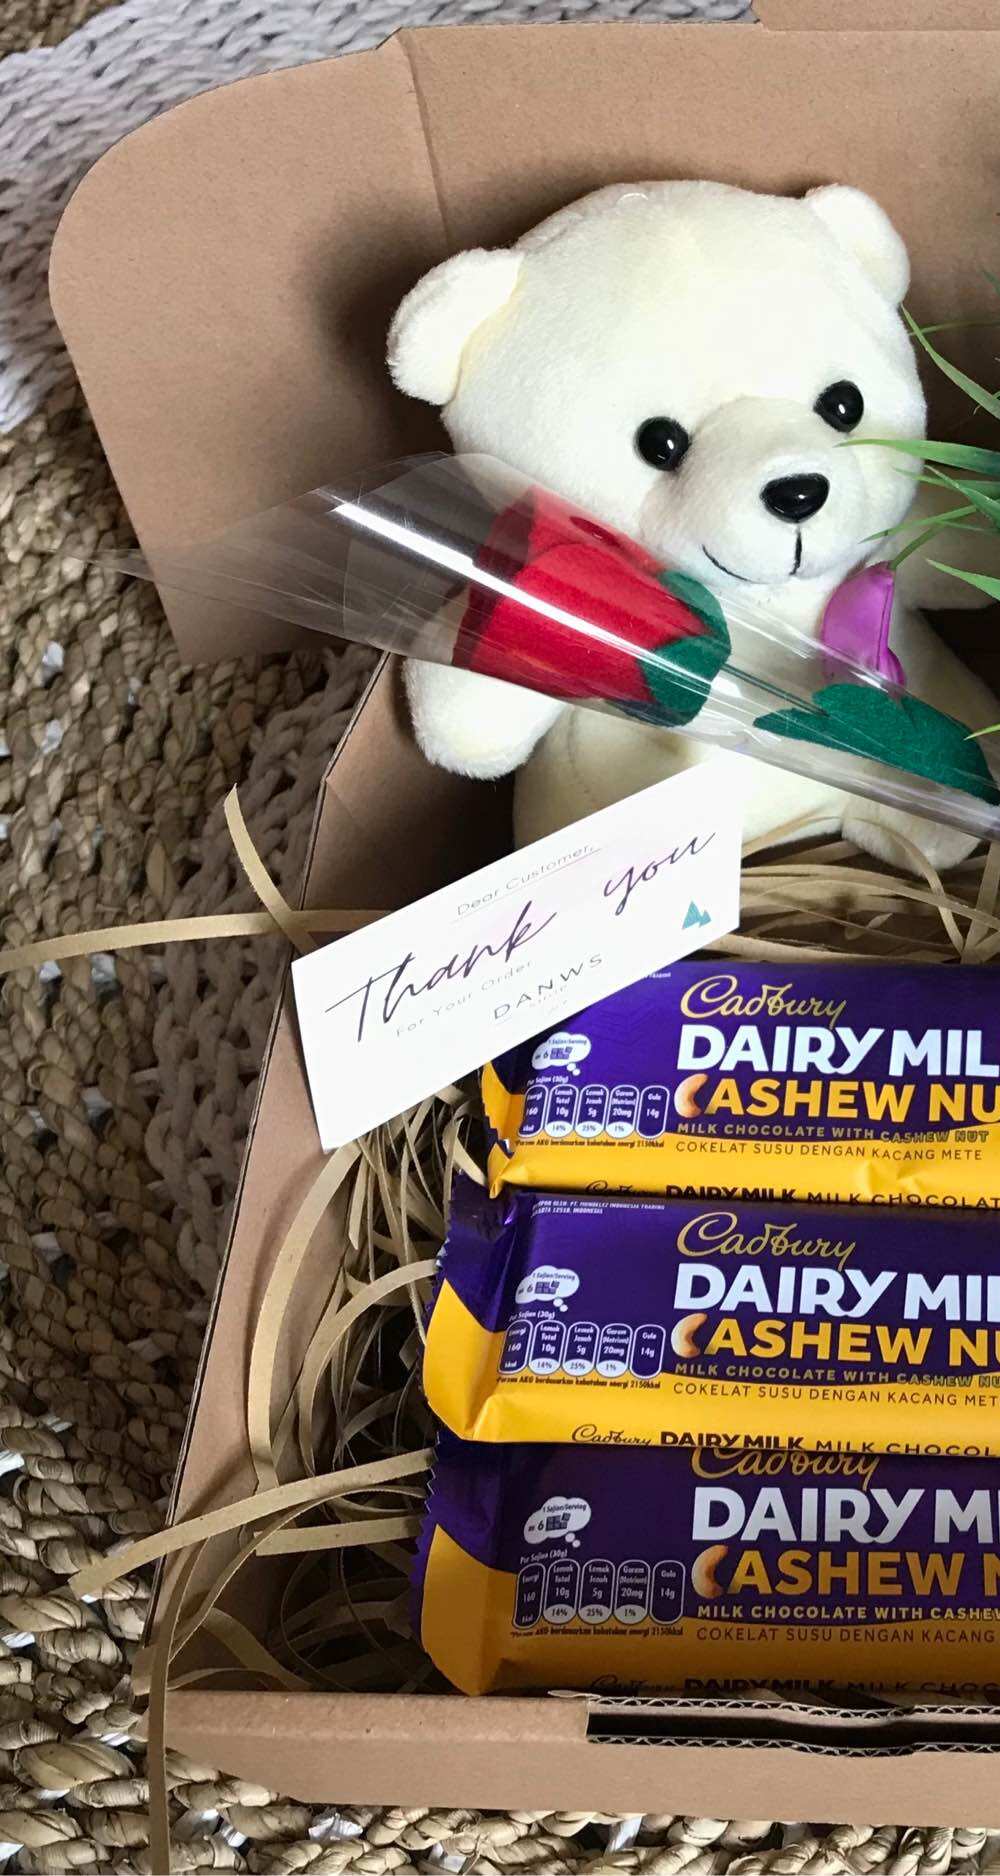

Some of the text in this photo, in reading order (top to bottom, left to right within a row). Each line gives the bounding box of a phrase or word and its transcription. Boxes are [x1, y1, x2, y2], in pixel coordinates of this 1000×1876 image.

[457, 887, 500, 916] Dear
[325, 831, 716, 1042] Thank you
[493, 956, 603, 1020] DANWS
[396, 961, 532, 1037] For Your Order
[680, 975, 846, 1030] Cadbury
[677, 1024, 885, 1075] DAIRY
[587, 1107, 598, 1117] 5g
[677, 1123, 989, 1144] MILK CHOCOLATE WITH CASHEW NUT
[676, 1141, 748, 1154] COKELAT
[753, 1142, 795, 1156] SUSU
[800, 1144, 866, 1158] DENGAN
[871, 1146, 936, 1161] KACANG
[942, 1148, 983, 1161] METE
[676, 1211, 856, 1271] Cadbury
[673, 1263, 897, 1318] DAIRY
[537, 1310, 556, 1320] (30g)
[541, 1344, 556, 1354] 10g
[576, 1345, 586, 1355] 5g
[603, 1346, 625, 1356] 20mg
[640, 1347, 655, 1357] 14g
[675, 1363, 718, 1377] MILK
[726, 1364, 836, 1382] CHOCOLATE
[843, 1369, 889, 1383] WITH
[896, 1372, 972, 1388] CASHEW
[673, 1383, 751, 1398] COKELAT
[758, 1385, 802, 1400] SUSU
[809, 1388, 880, 1403] DENGAN
[887, 1391, 957, 1406] KACANG
[660, 1431, 741, 1448] DAIRY
[743, 1434, 804, 1450] MILK
[815, 1441, 873, 1454] MILK
[691, 1486, 925, 1544] DAIRY
[537, 1520, 544, 1530] 6
[555, 1587, 570, 1598] 10g
[592, 1587, 603, 1599] 5g
[621, 1588, 644, 1599] 20mg
[660, 1588, 675, 1599] 14g
[586, 1608, 604, 1617] 25%
[624, 1608, 636, 1617] 1%
[698, 1605, 744, 1619] MILK
[751, 1605, 868, 1620] CHOCOLATE
[874, 1606, 924, 1620] WITH
[696, 1626, 779, 1642] COKELAT
[785, 1627, 833, 1642] SUSU
[839, 1628, 912, 1643] DENGAN
[921, 1629, 995, 1644] KACANG
